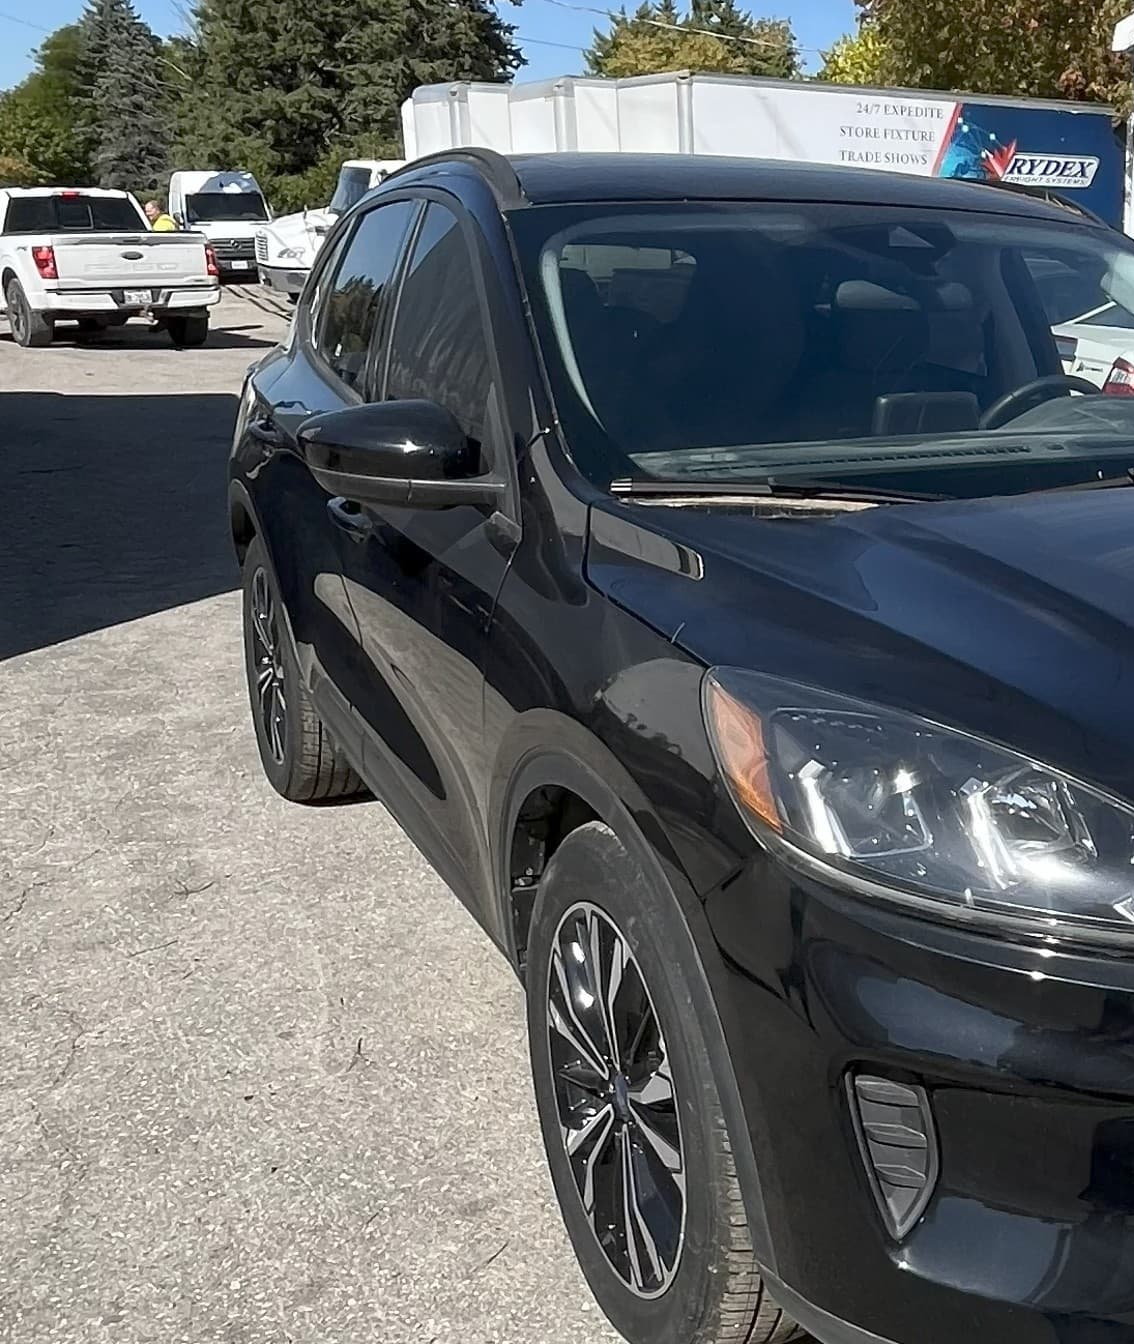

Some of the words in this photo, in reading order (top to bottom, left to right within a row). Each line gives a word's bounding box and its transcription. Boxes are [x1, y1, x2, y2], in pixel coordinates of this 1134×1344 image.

[856, 102, 881, 115] 24/7
[884, 103, 944, 119] EXPEDITE
[839, 125, 881, 138] STORE
[883, 127, 936, 142] FIXTURE
[838, 149, 881, 163] TRADE
[883, 151, 929, 165] SHOWS
[1006, 157, 1095, 179] RYDEX
